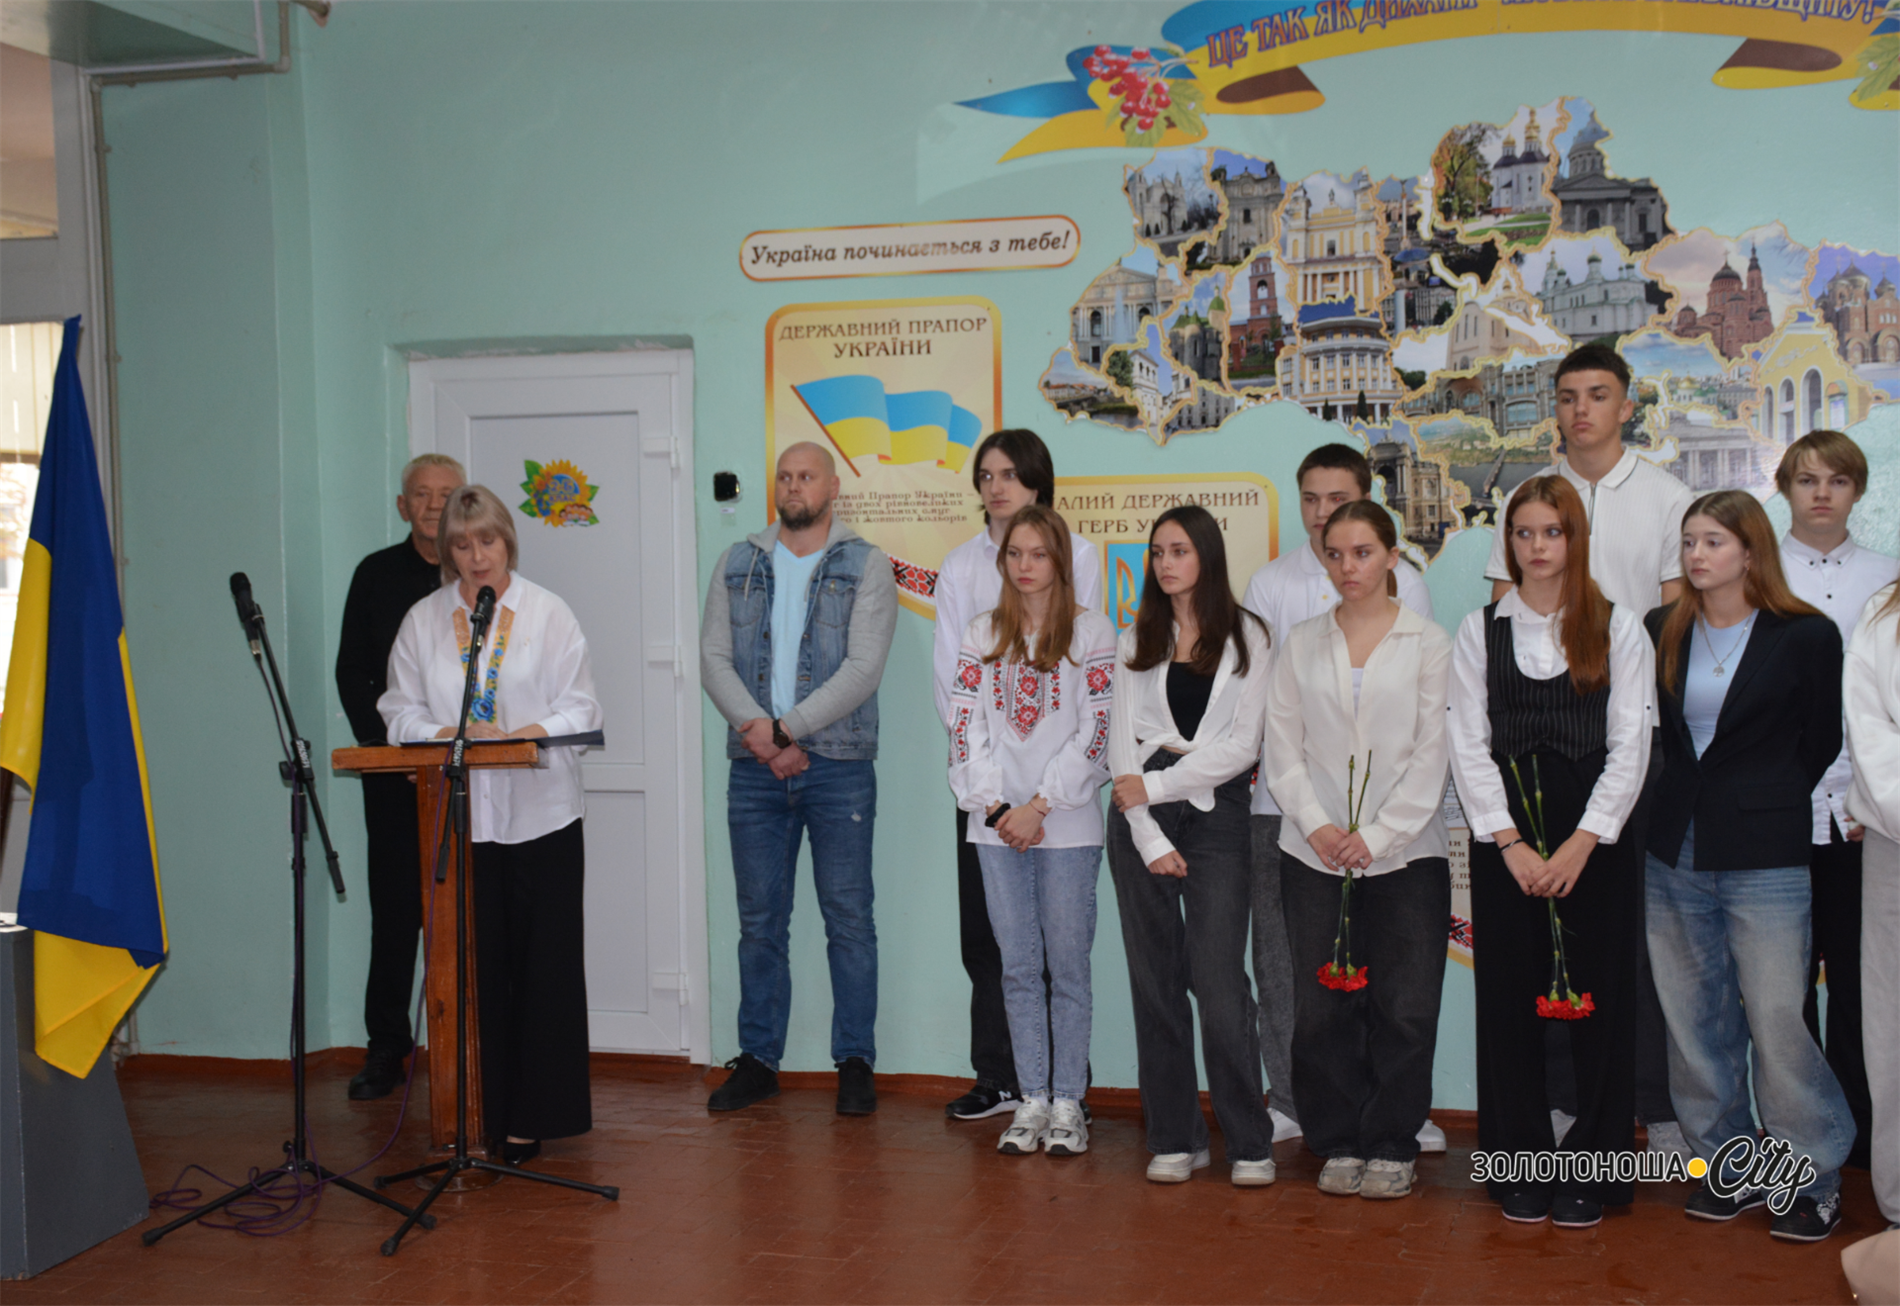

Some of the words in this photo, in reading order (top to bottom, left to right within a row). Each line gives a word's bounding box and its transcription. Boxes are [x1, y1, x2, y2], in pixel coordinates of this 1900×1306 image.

[1206, 23, 1248, 69] ЦЕ
[1251, 5, 1310, 53] ТАК
[1313, 0, 1357, 37] ЯК
[751, 245, 837, 267] Україна
[844, 239, 983, 262] починається
[989, 240, 1000, 254] з
[1008, 230, 1070, 253] тебе!
[778, 319, 901, 342] ДЕРЖАВНИЙ
[908, 317, 988, 335] ПРАПОР
[833, 337, 932, 359] УКРАЇНИ
[869, 491, 912, 502] Прапор
[915, 490, 963, 502] України
[1052, 492, 1115, 510] АЛИЙ
[1121, 489, 1259, 512] ДЕРЖАВНИЙ
[1078, 519, 1128, 534] ГЕРБ
